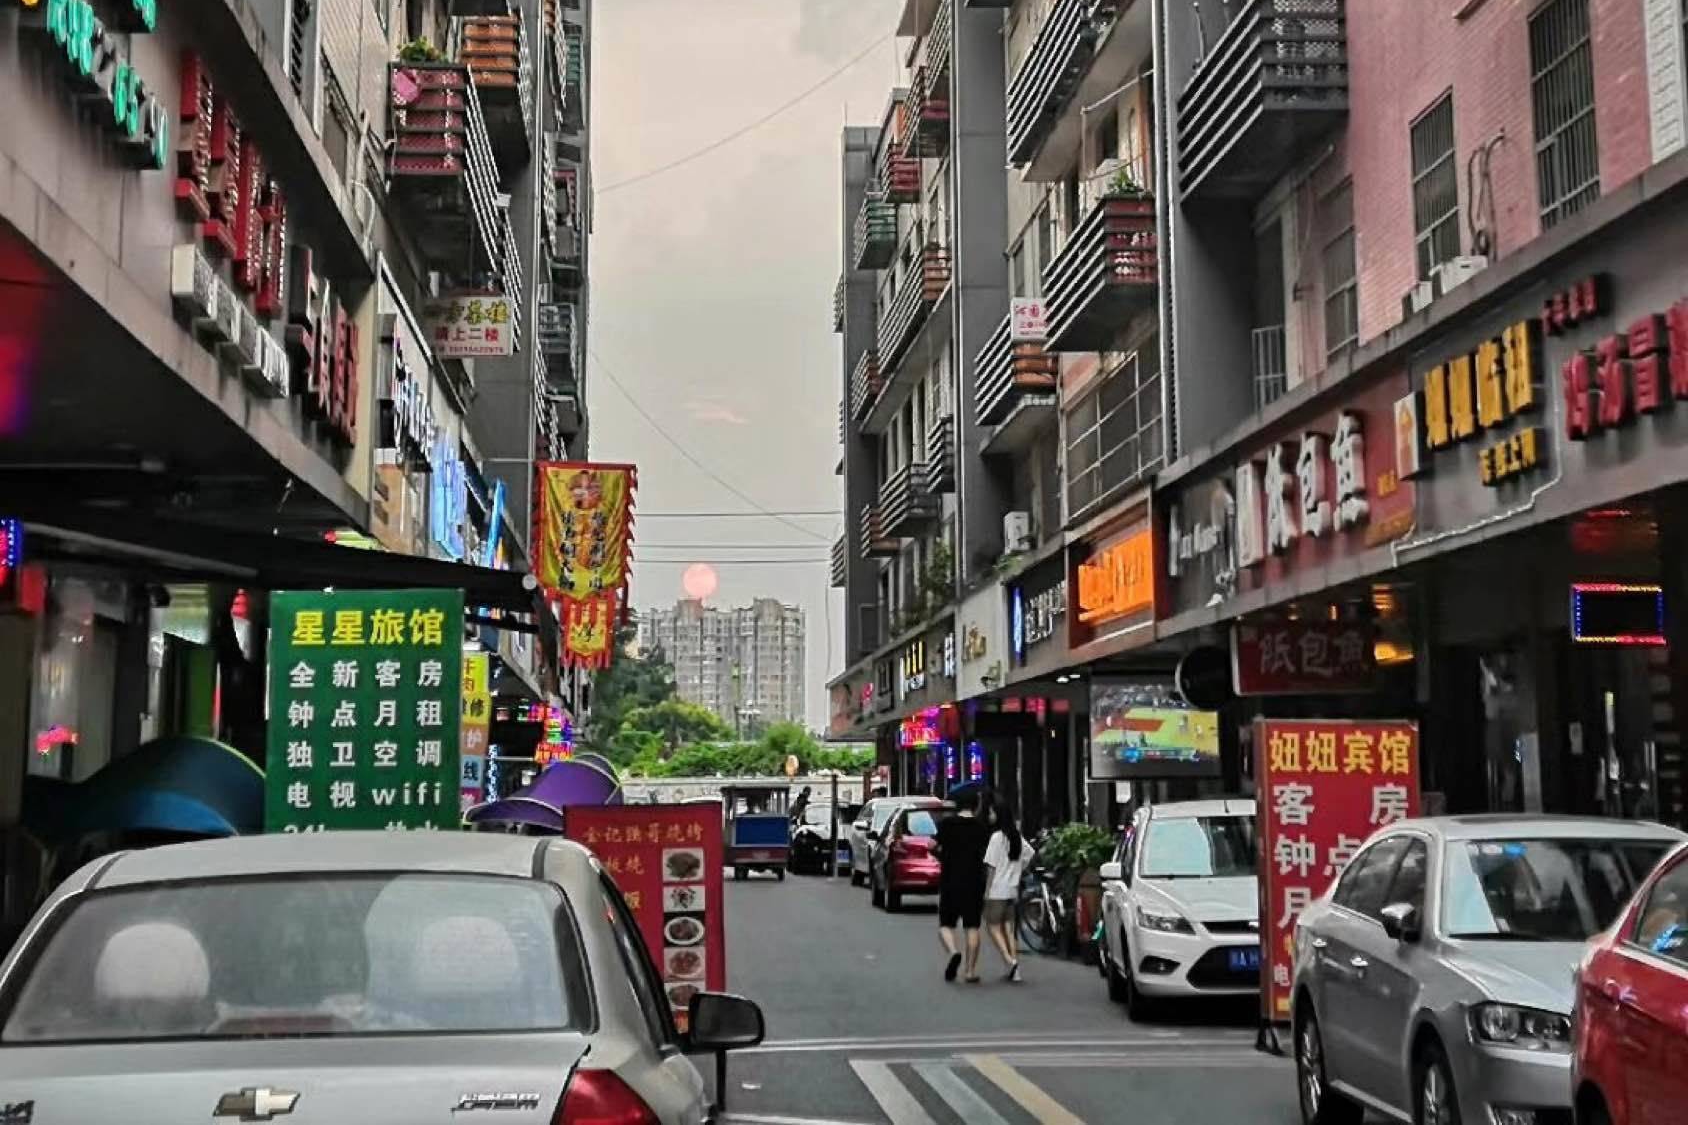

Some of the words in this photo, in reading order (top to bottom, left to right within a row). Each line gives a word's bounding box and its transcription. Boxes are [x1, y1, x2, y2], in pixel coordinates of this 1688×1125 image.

[291, 608, 444, 646] 星星旅馆
[289, 659, 443, 688] 全新客房
[288, 700, 443, 729] 钟点月租
[287, 740, 442, 768] 独卫空调
[1269, 730, 1411, 774] 妞妞宾馆
[287, 781, 356, 808] 电视
[372, 781, 442, 806] wifi
[1273, 782, 1409, 825] 客房
